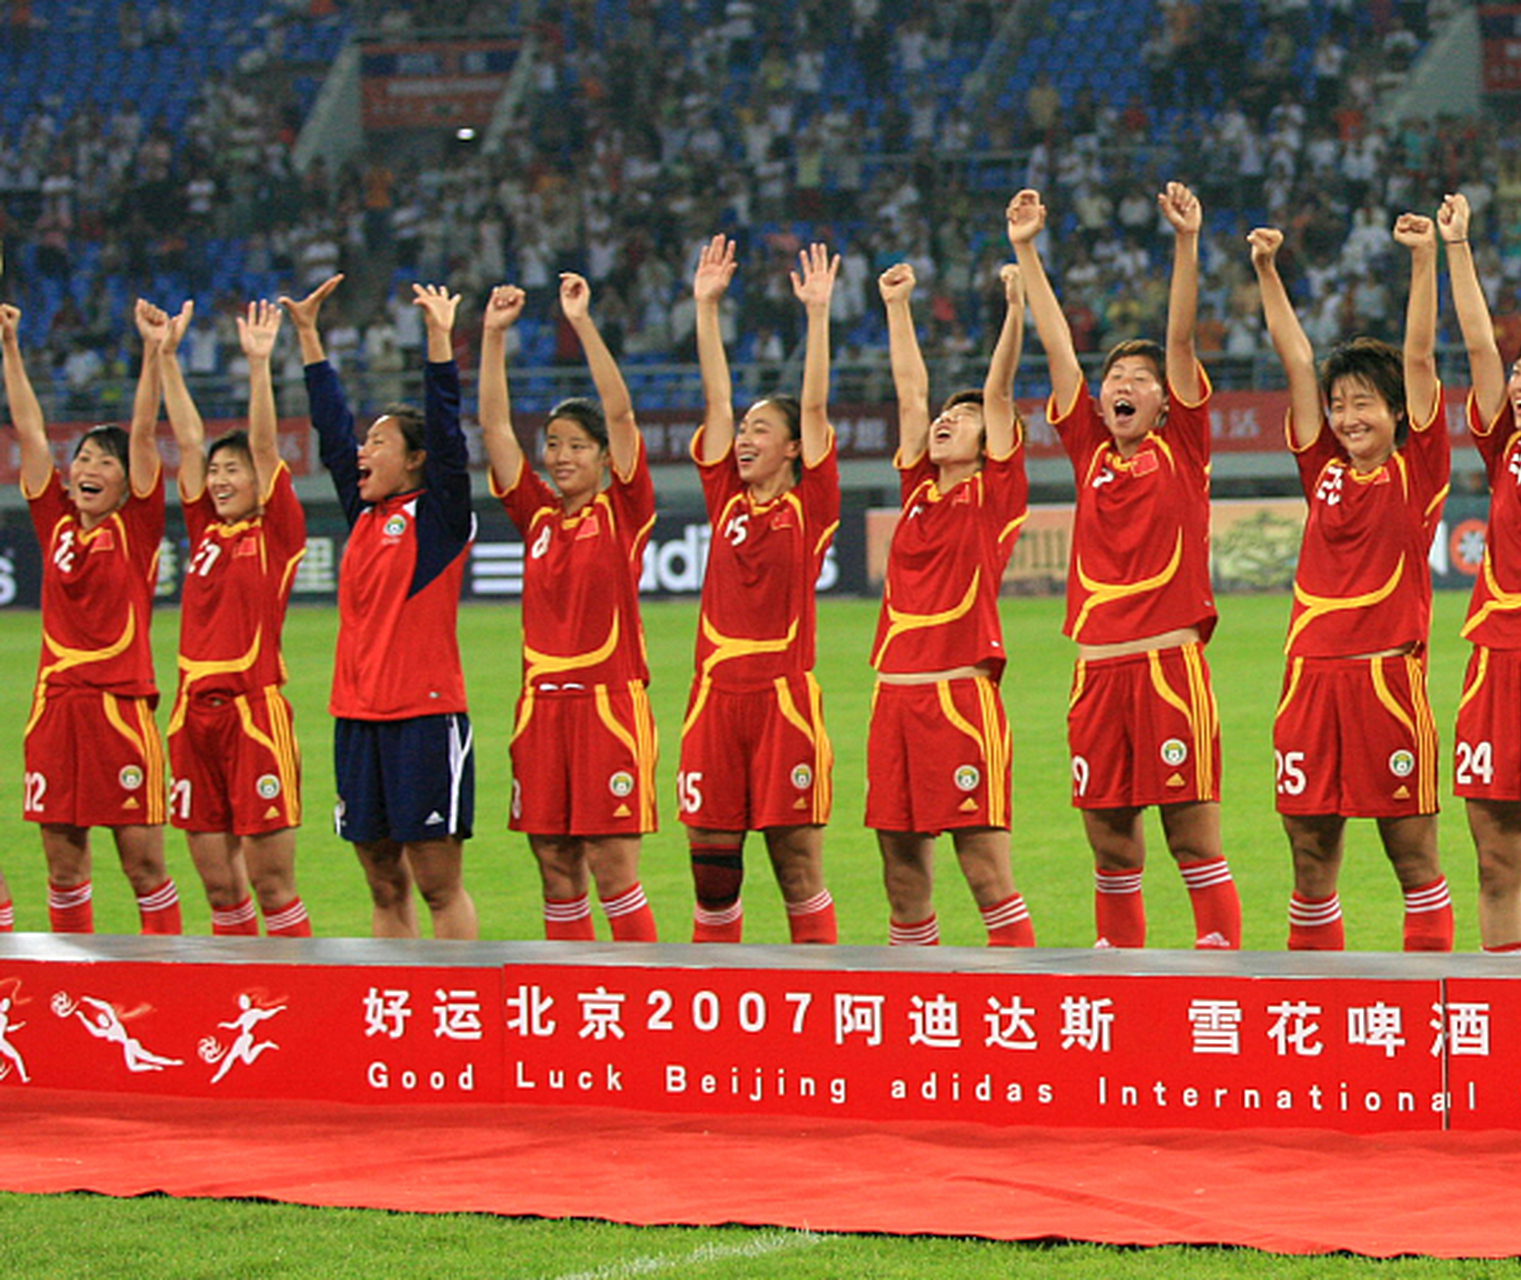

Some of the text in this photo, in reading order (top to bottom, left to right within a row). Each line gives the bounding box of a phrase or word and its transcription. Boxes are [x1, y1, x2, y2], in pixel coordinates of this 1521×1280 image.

[1456, 742, 1493, 785] 24
[363, 985, 1115, 1052] 好运北京2007阿迪达斯
[1188, 999, 1490, 1057] 雪花啤酒
[367, 1061, 474, 1090] Good
[515, 1061, 623, 1091] Luck
[666, 1065, 847, 1104] Beijing
[891, 1072, 1053, 1105] adidas
[1099, 1076, 1475, 1113] International
